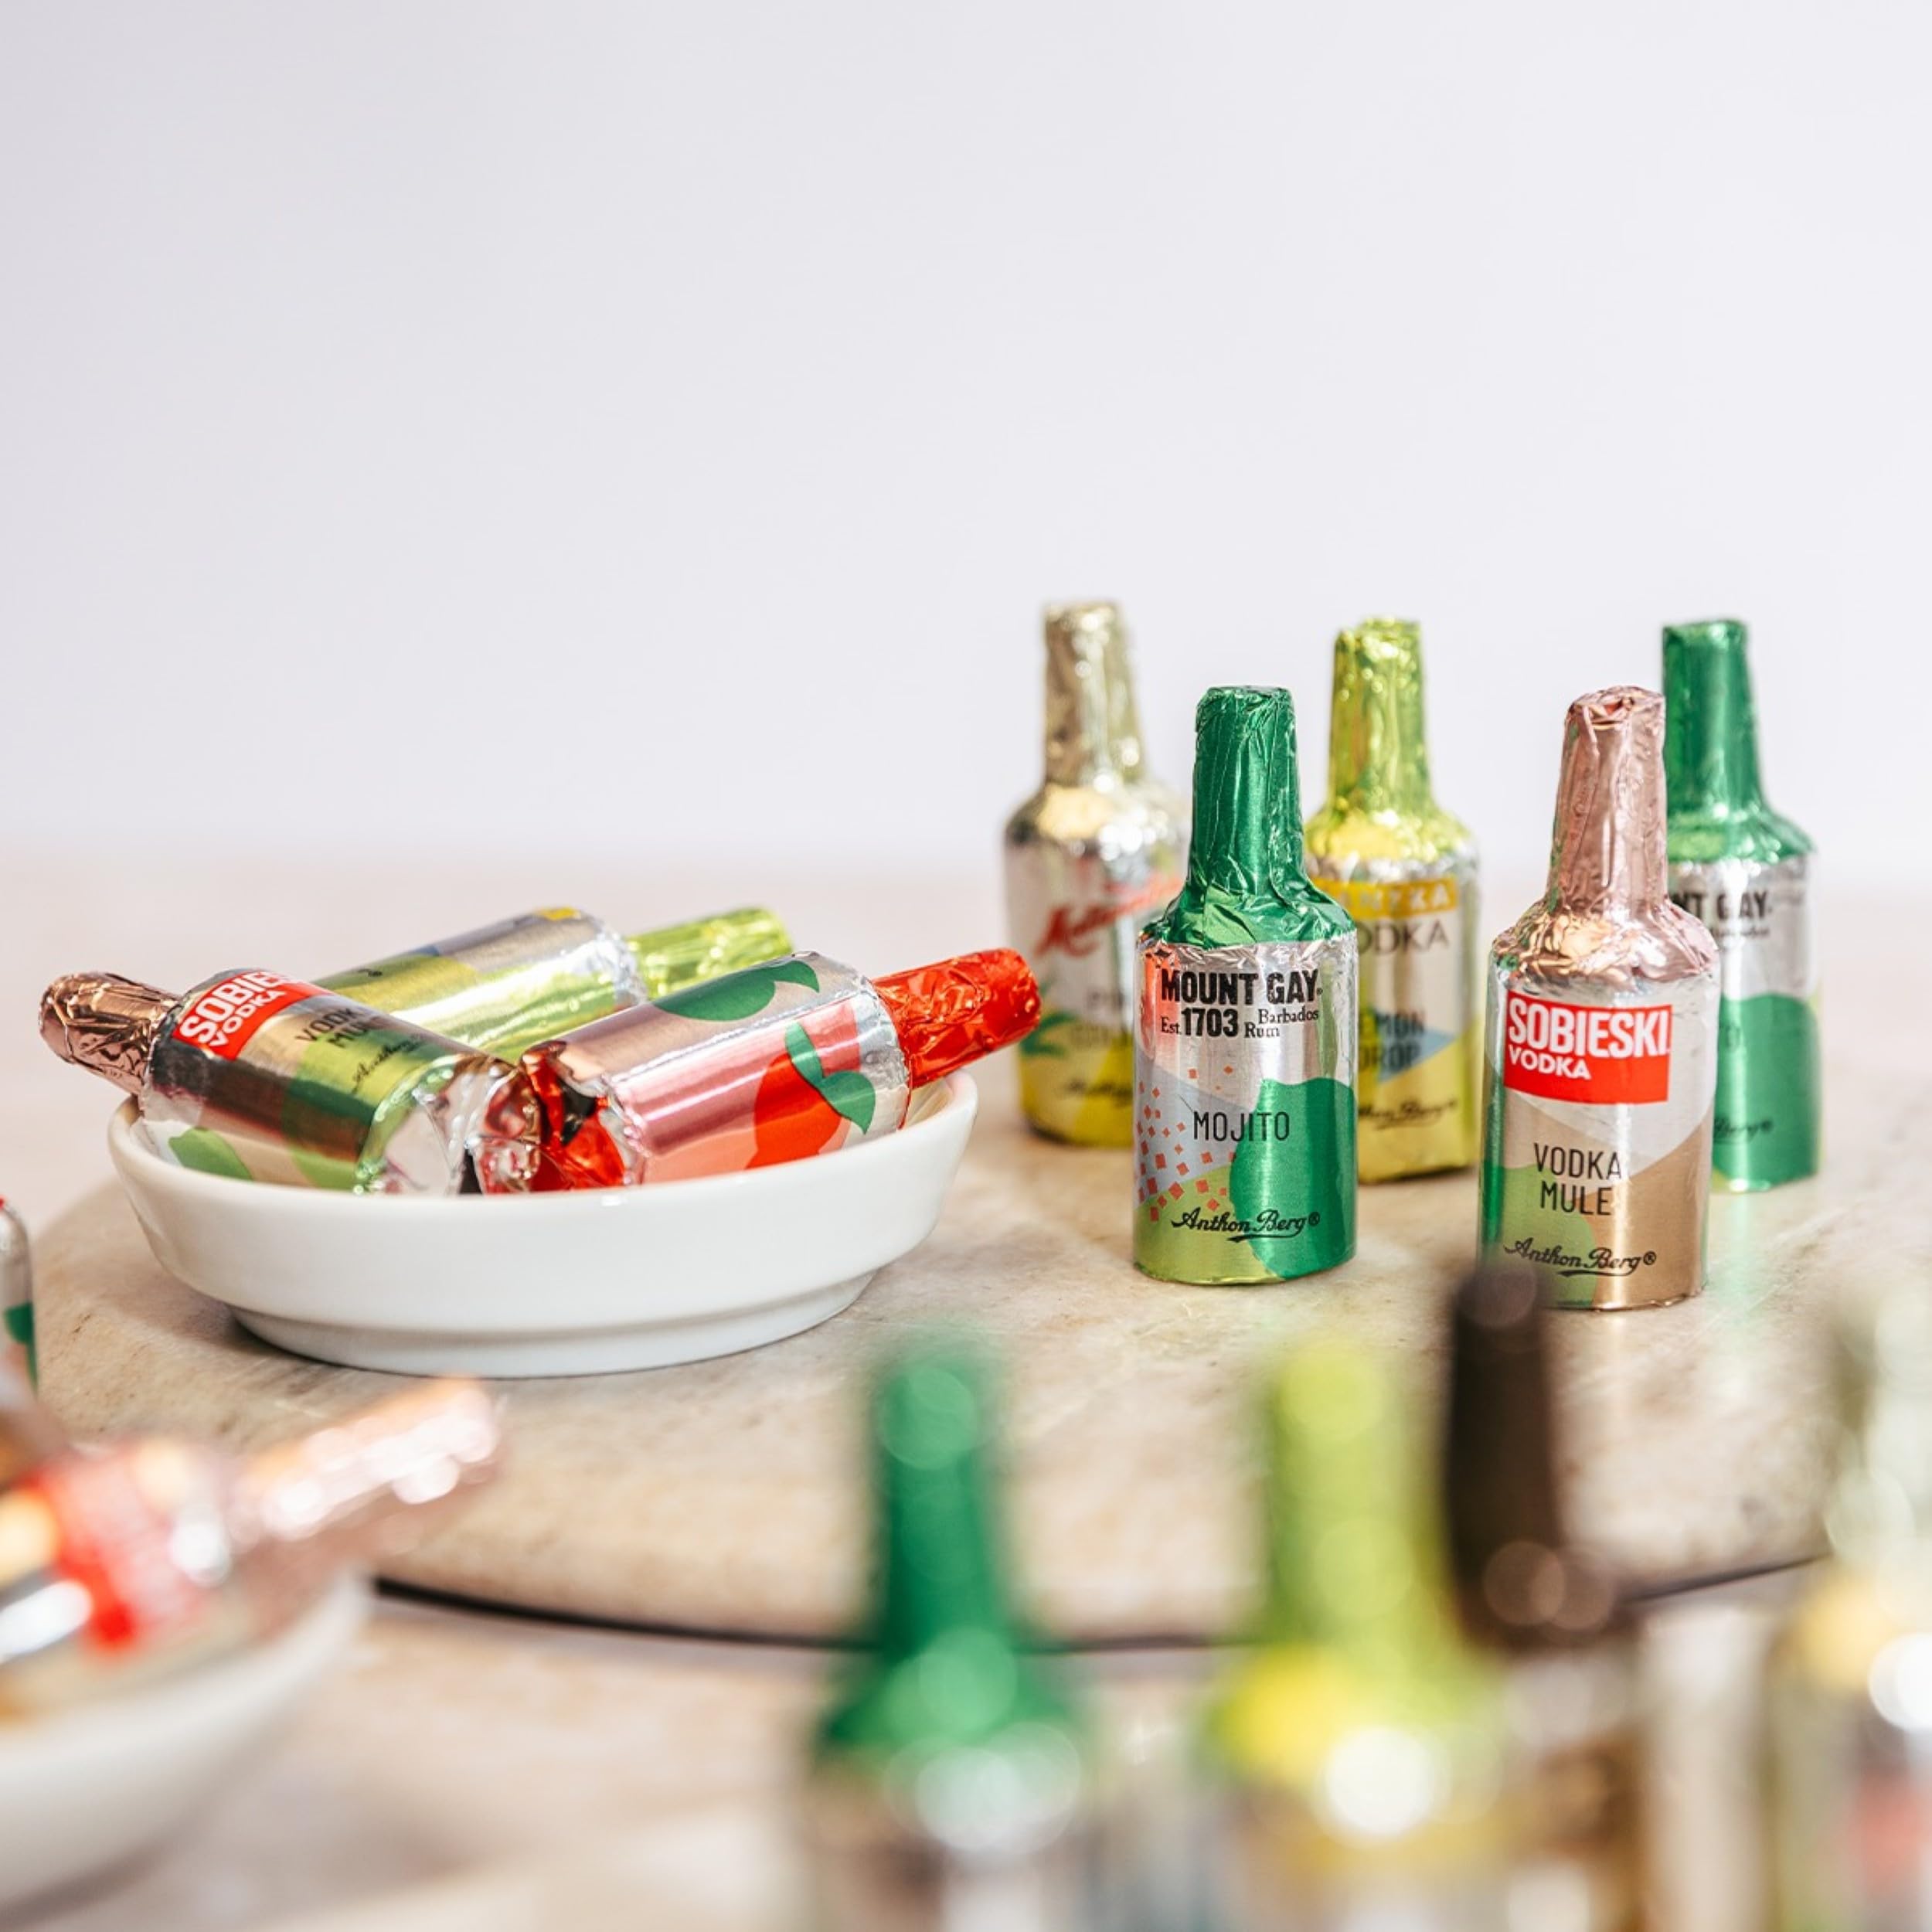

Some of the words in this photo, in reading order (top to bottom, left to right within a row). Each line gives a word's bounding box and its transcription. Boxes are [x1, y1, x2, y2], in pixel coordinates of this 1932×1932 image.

[1161, 969, 1259, 1005] MOUNT
[209, 989, 287, 1047] VODKA
[295, 1007, 360, 1042] VODK
[1182, 1007, 1239, 1037] 1703
[1244, 1022, 1280, 1039] Rum
[1258, 1006, 1319, 1024] Barbados
[1508, 997, 1671, 1058] SOBIESKI
[1509, 1046, 1591, 1080] VODKA
[1192, 1111, 1290, 1142] MOJITO
[1533, 1142, 1622, 1180] VODKA
[1539, 1181, 1613, 1216] MULE
[1171, 1207, 1251, 1232] Anthon
[1503, 1237, 1582, 1268] Anthon
